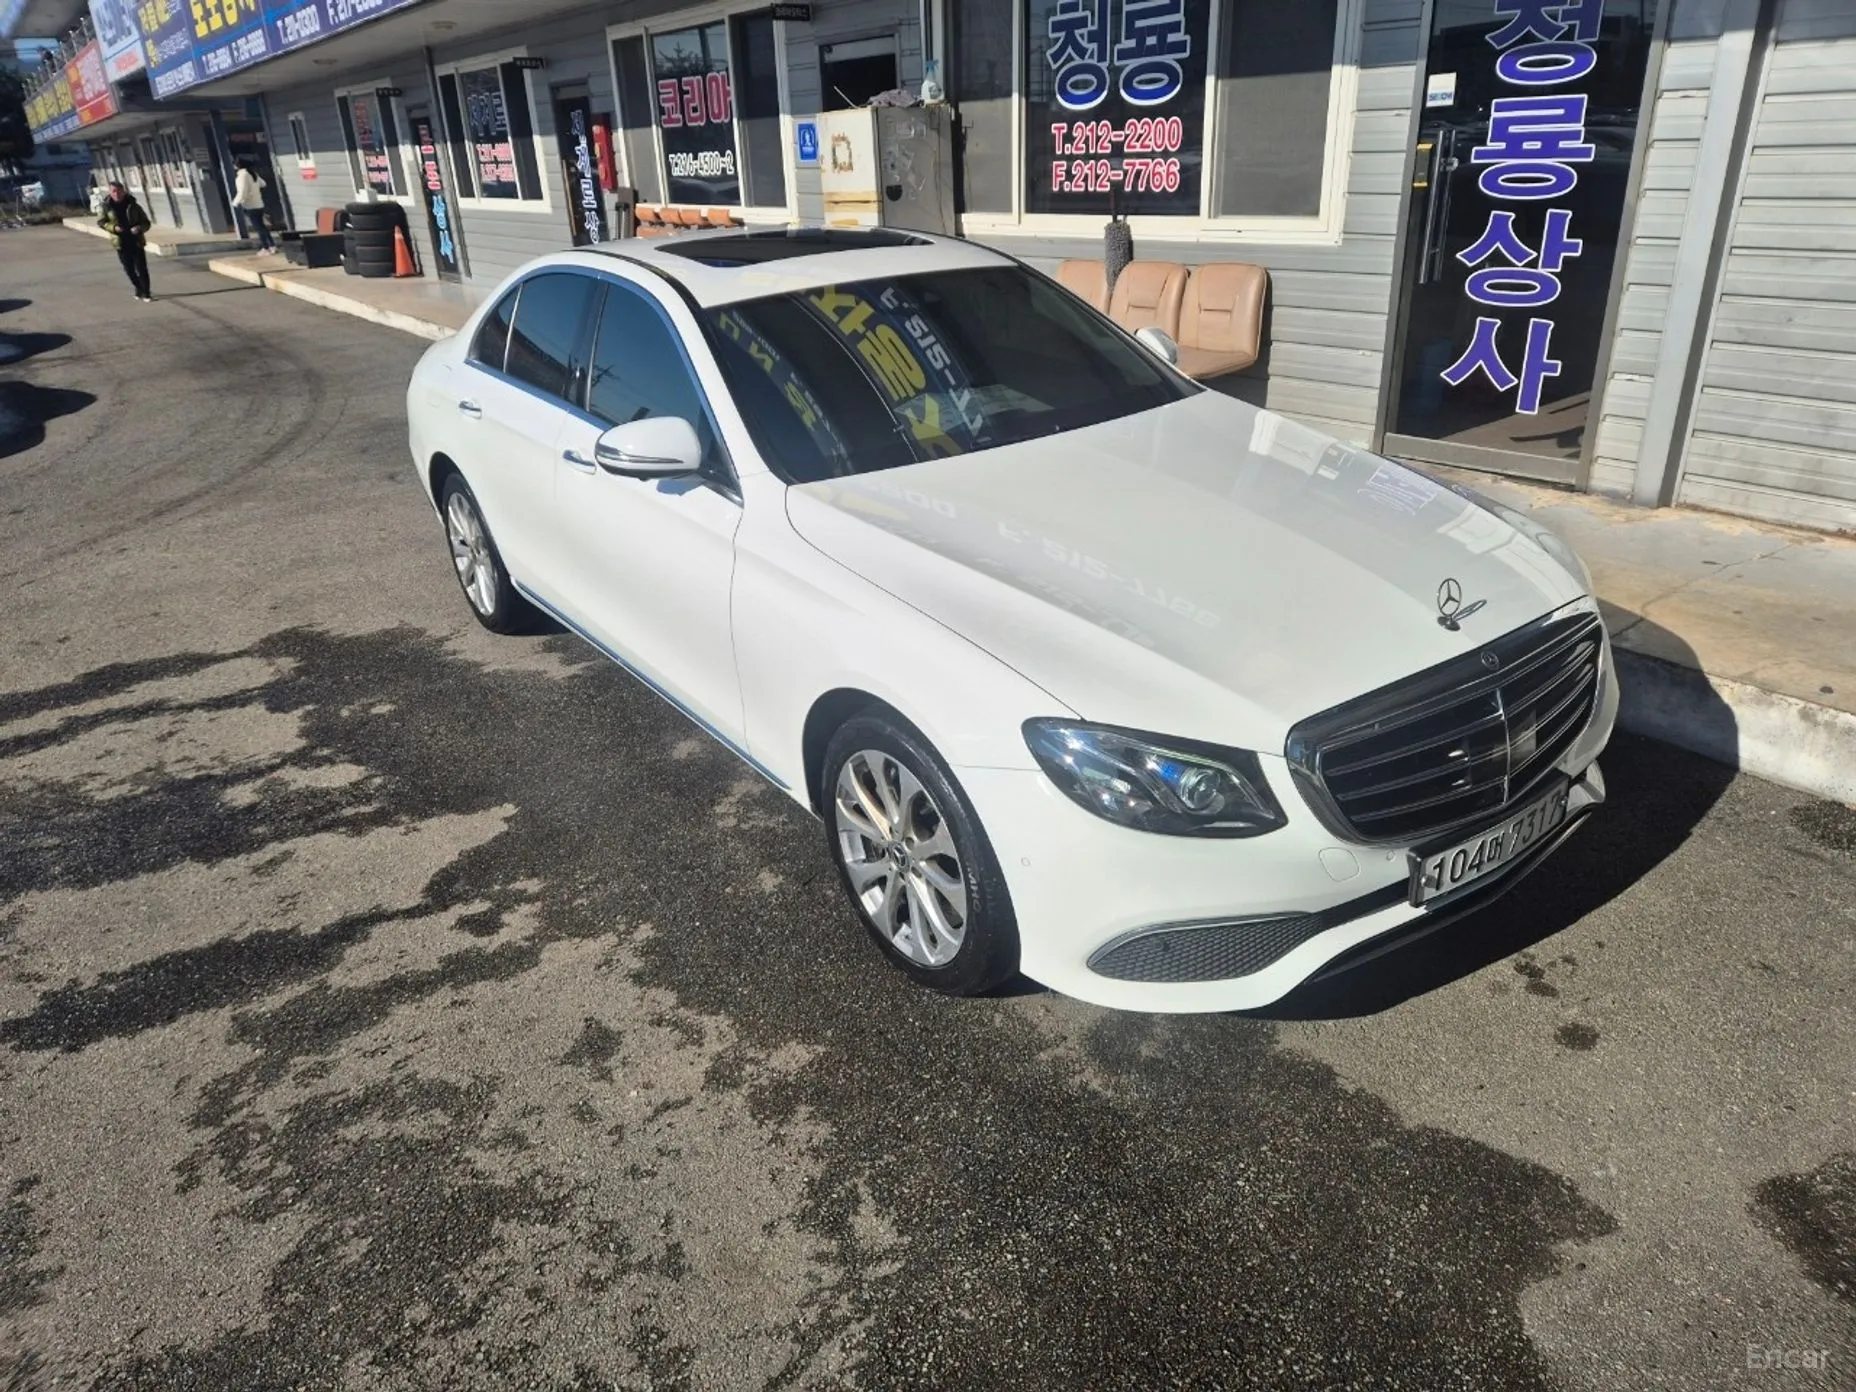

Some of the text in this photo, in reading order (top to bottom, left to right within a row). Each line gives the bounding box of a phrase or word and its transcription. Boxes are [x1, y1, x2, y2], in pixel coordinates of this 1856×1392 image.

[1046, 0, 1191, 110] 청룡
[658, 71, 732, 128] 코리아
[1051, 116, 1182, 154] T.212-2200
[1052, 158, 1180, 192] F.212-7766
[1441, 0, 1604, 415] 청룡상사
